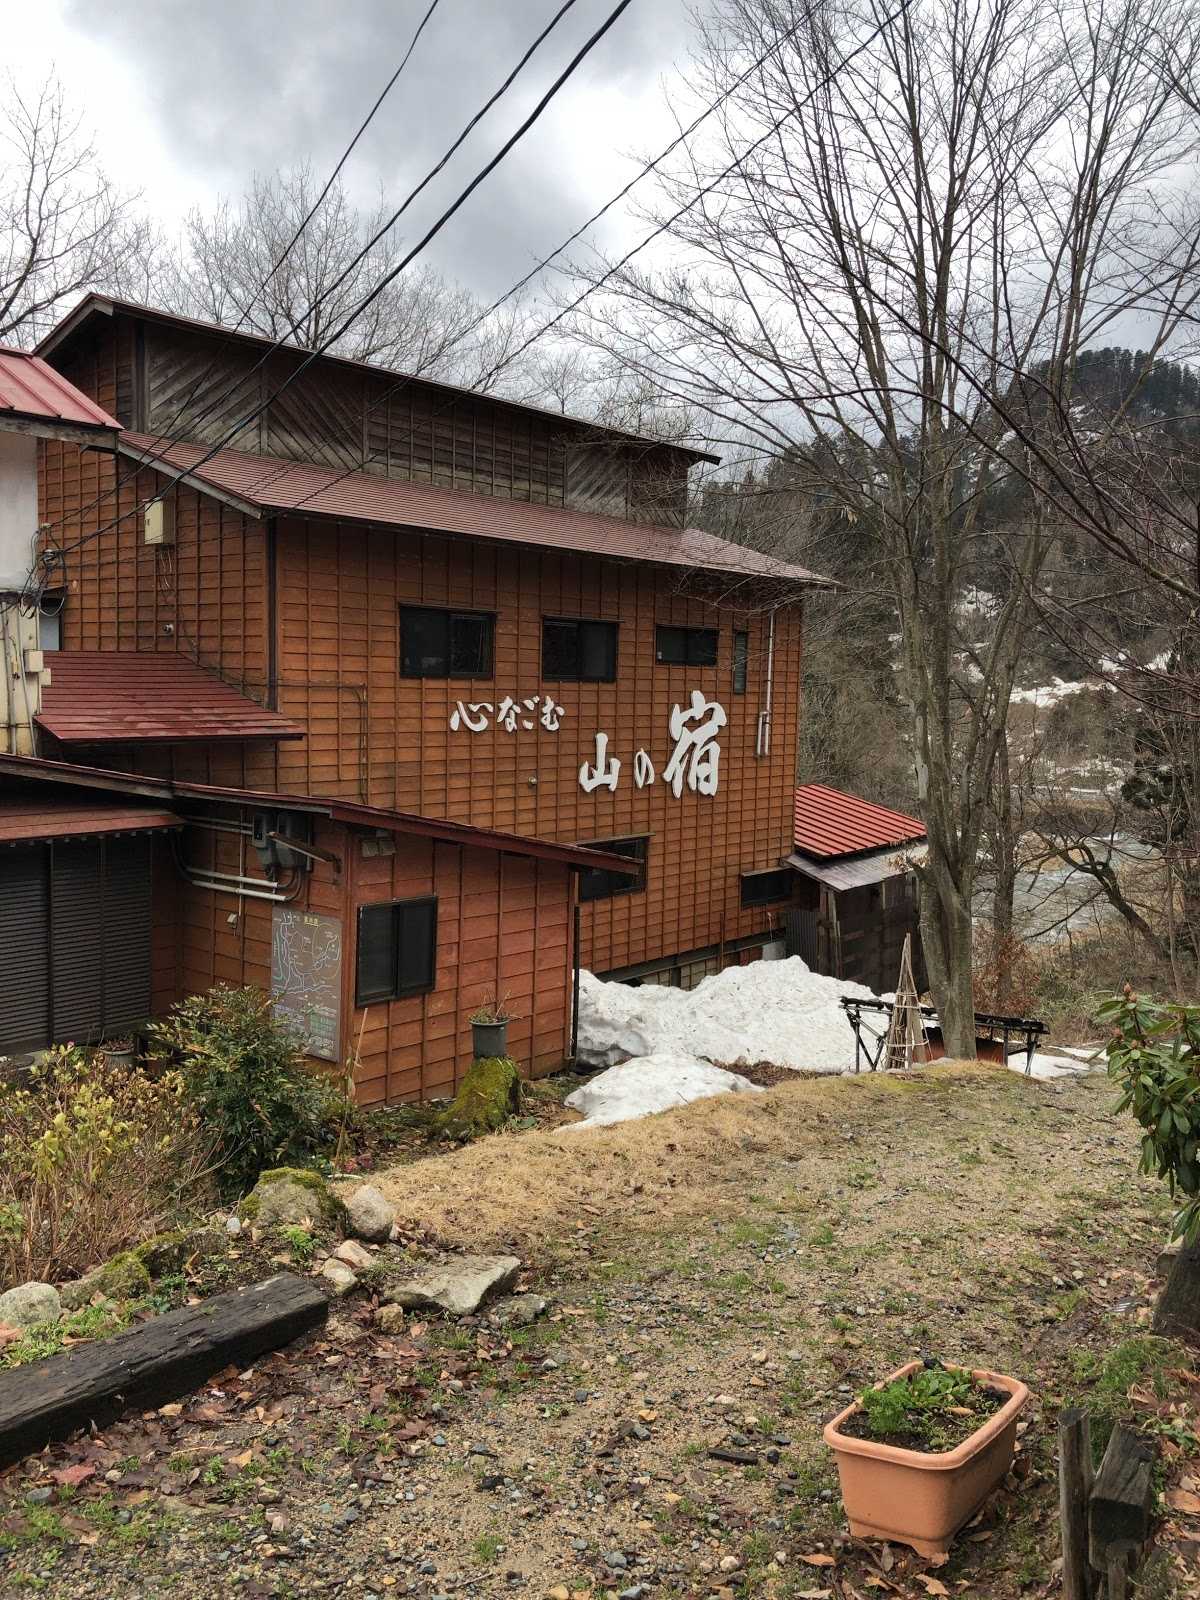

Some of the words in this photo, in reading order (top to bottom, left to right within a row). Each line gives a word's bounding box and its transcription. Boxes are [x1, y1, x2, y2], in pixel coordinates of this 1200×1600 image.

[450, 695, 565, 732] 心なごむ
[579, 690, 728, 799] 山の宿
